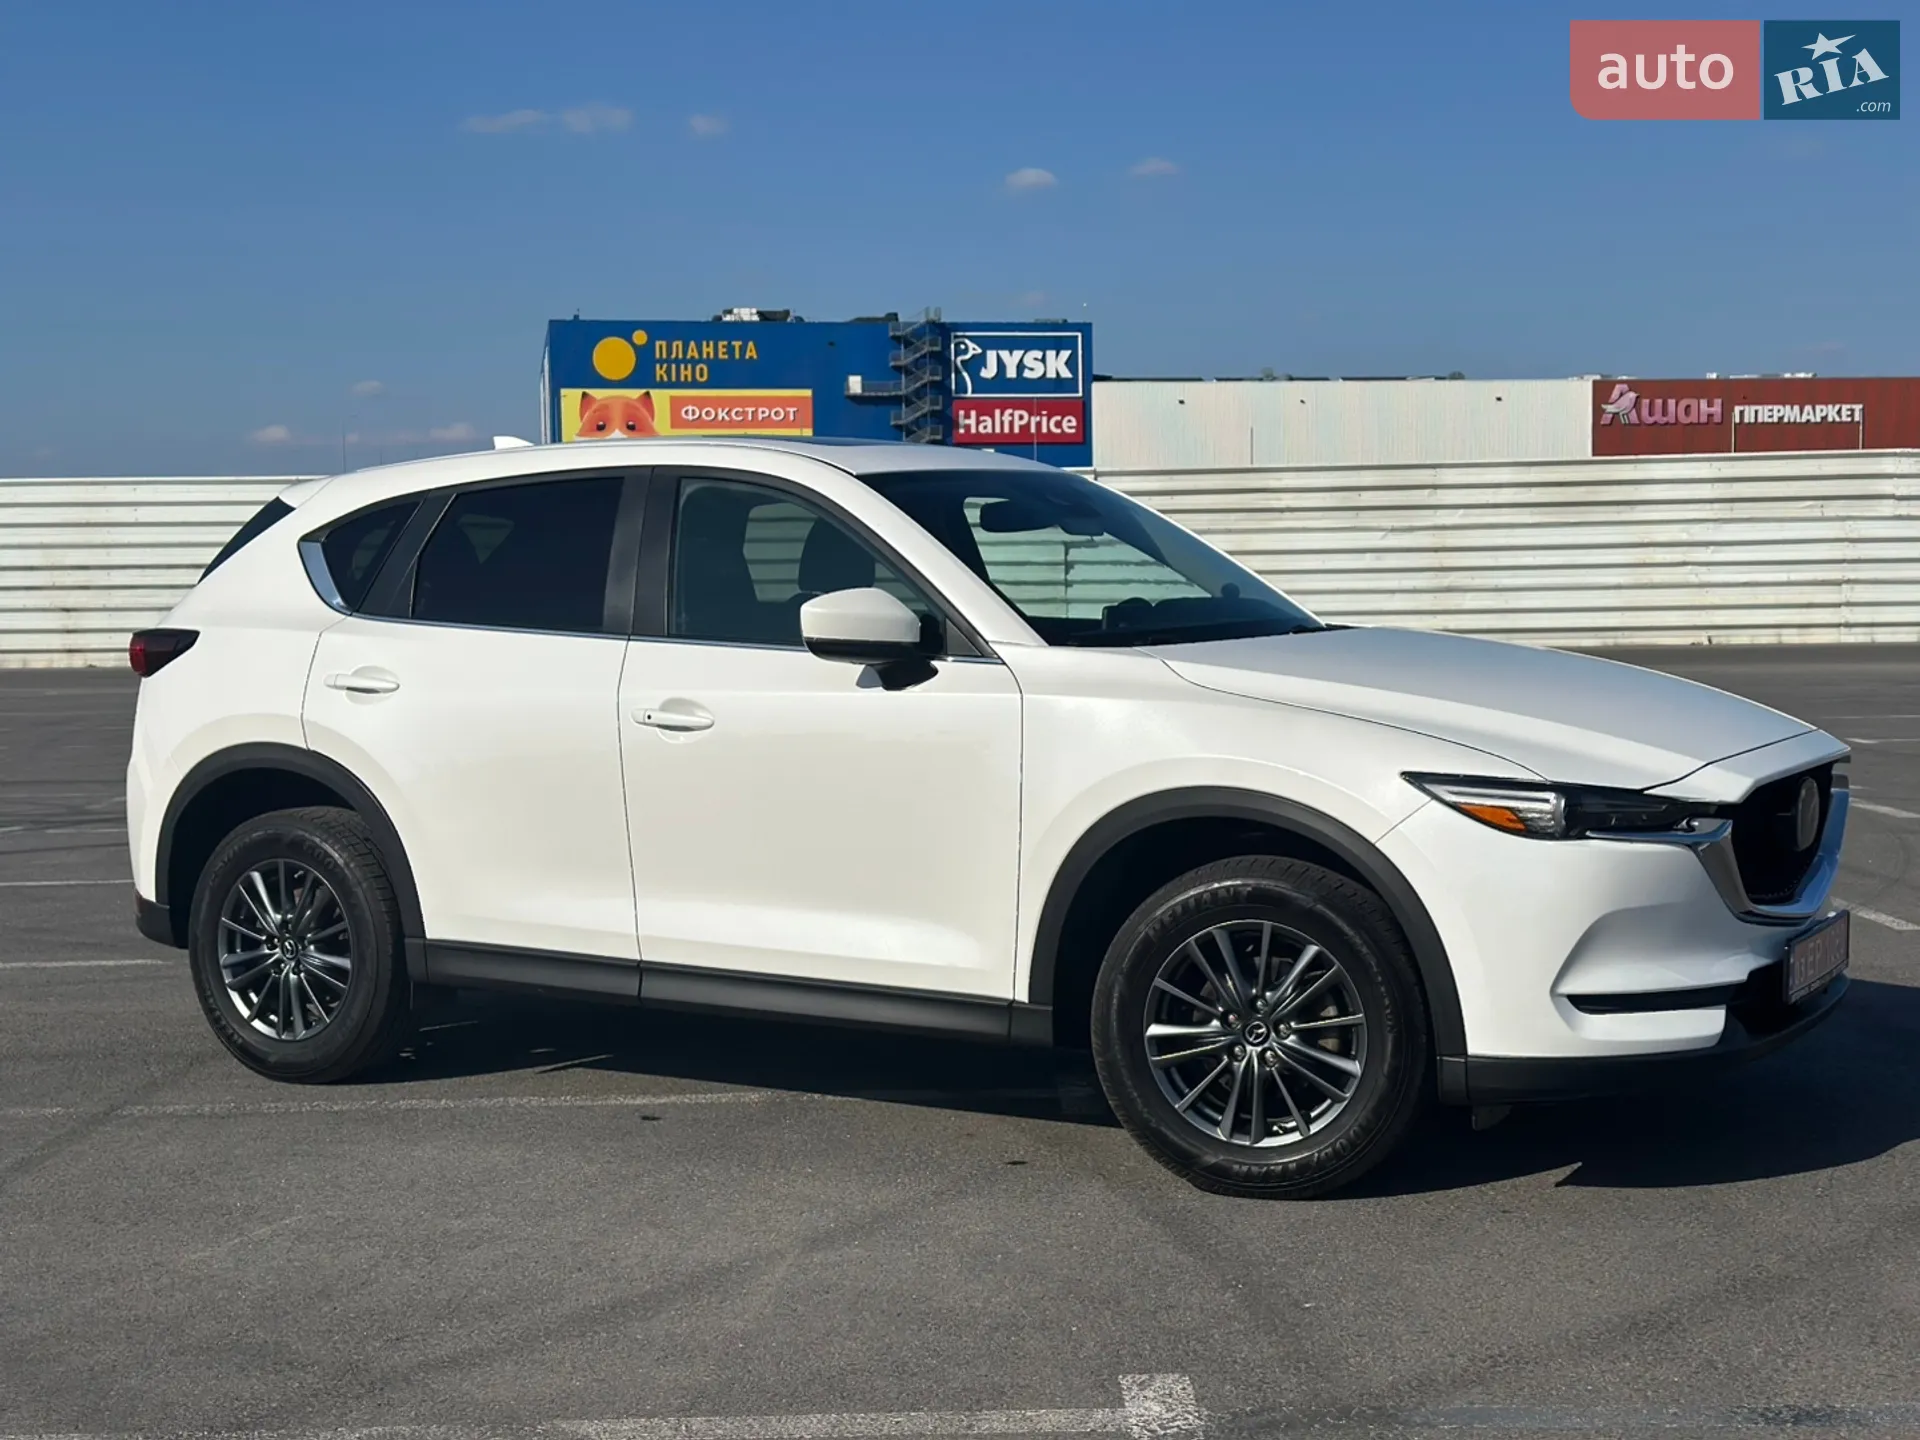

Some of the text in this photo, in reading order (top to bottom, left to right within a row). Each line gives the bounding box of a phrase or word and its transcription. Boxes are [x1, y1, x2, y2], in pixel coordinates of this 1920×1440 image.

[654, 340, 758, 360] ПЛАНЕТА
[655, 363, 709, 382] КІНО
[979, 350, 1073, 379] JYSK
[681, 405, 798, 421] ФОКСТРОТ
[958, 409, 1078, 434] HalfPrice
[1734, 403, 1863, 424] ГІПЕРМАРКЕТ
